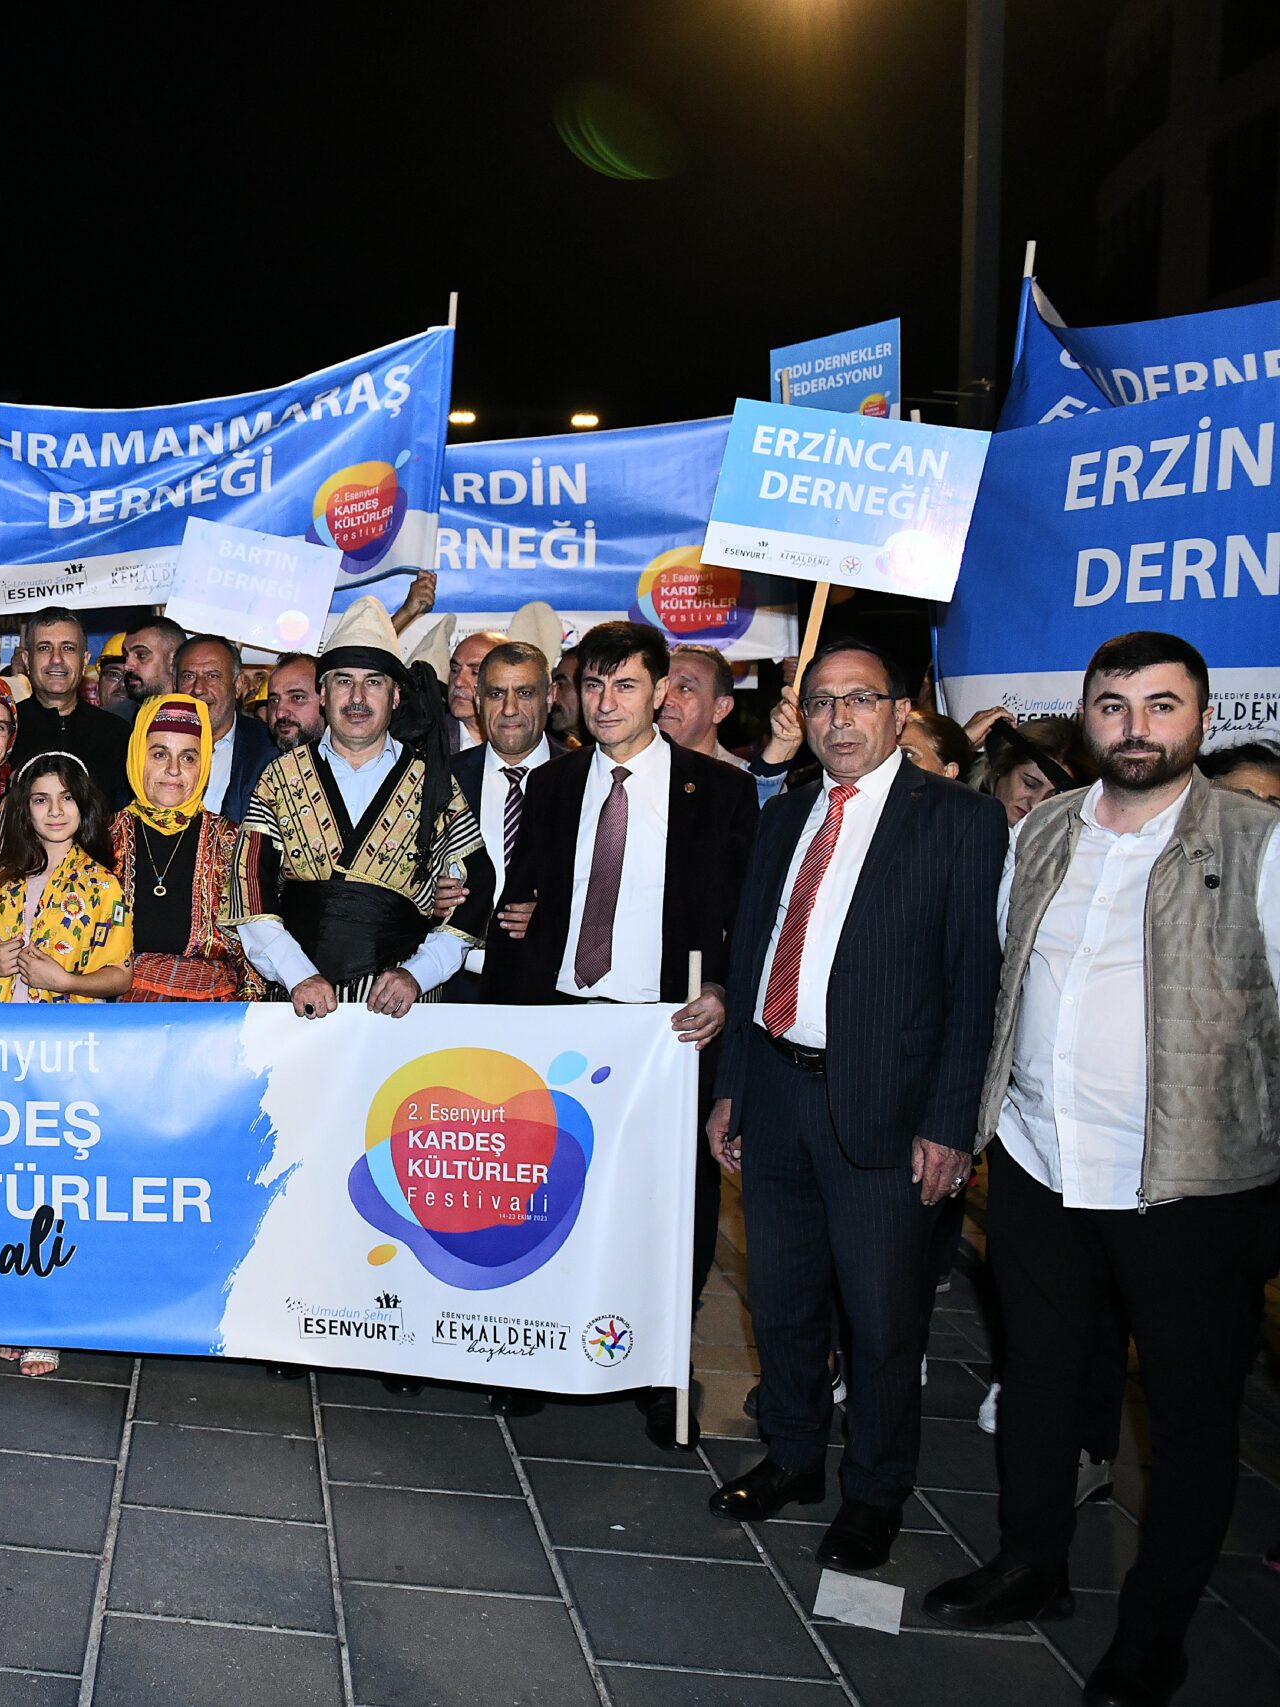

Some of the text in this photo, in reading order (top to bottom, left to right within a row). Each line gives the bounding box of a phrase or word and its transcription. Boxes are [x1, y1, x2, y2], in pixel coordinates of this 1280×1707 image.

[815, 342, 892, 373] DERNEKLER
[752, 425, 949, 480] ERZİNCAN
[1063, 416, 1276, 512] ERZİN
[48, 446, 273, 530] DERNEĞİ
[334, 486, 379, 503] 2. Esenyurt
[759, 470, 930, 526] DERNEĞİ
[334, 498, 379, 516] KARDEŞ
[334, 505, 394, 530] KÜLTÜRLER
[334, 518, 393, 542] Festivali
[219, 539, 298, 573] BARTIN
[724, 547, 766, 560] ESENYURT
[672, 573, 714, 584] Esenyurt
[7, 582, 85, 600] ESENYURT
[660, 585, 714, 597] KARDEŞ
[660, 597, 737, 611] KÜLTÜRLER
[660, 613, 737, 623] Festivali
[1024, 698, 1073, 711] Umudun
[1208, 692, 1249, 700] BELEDİYE
[408, 1103, 505, 1125] 2. Esenyurt
[408, 1130, 505, 1157] KARDEŞ
[408, 1155, 549, 1184] KÜLTÜRLER
[407, 1187, 548, 1213] Festivali
[533, 1214, 548, 1222] 2023
[311, 1305, 393, 1322] Umudun Şehri
[441, 1311, 559, 1329] ESENYURT BELEDİYE BAŞKANI
[304, 1317, 400, 1341] ESENYURT
[466, 1340, 538, 1362] bozkurt
